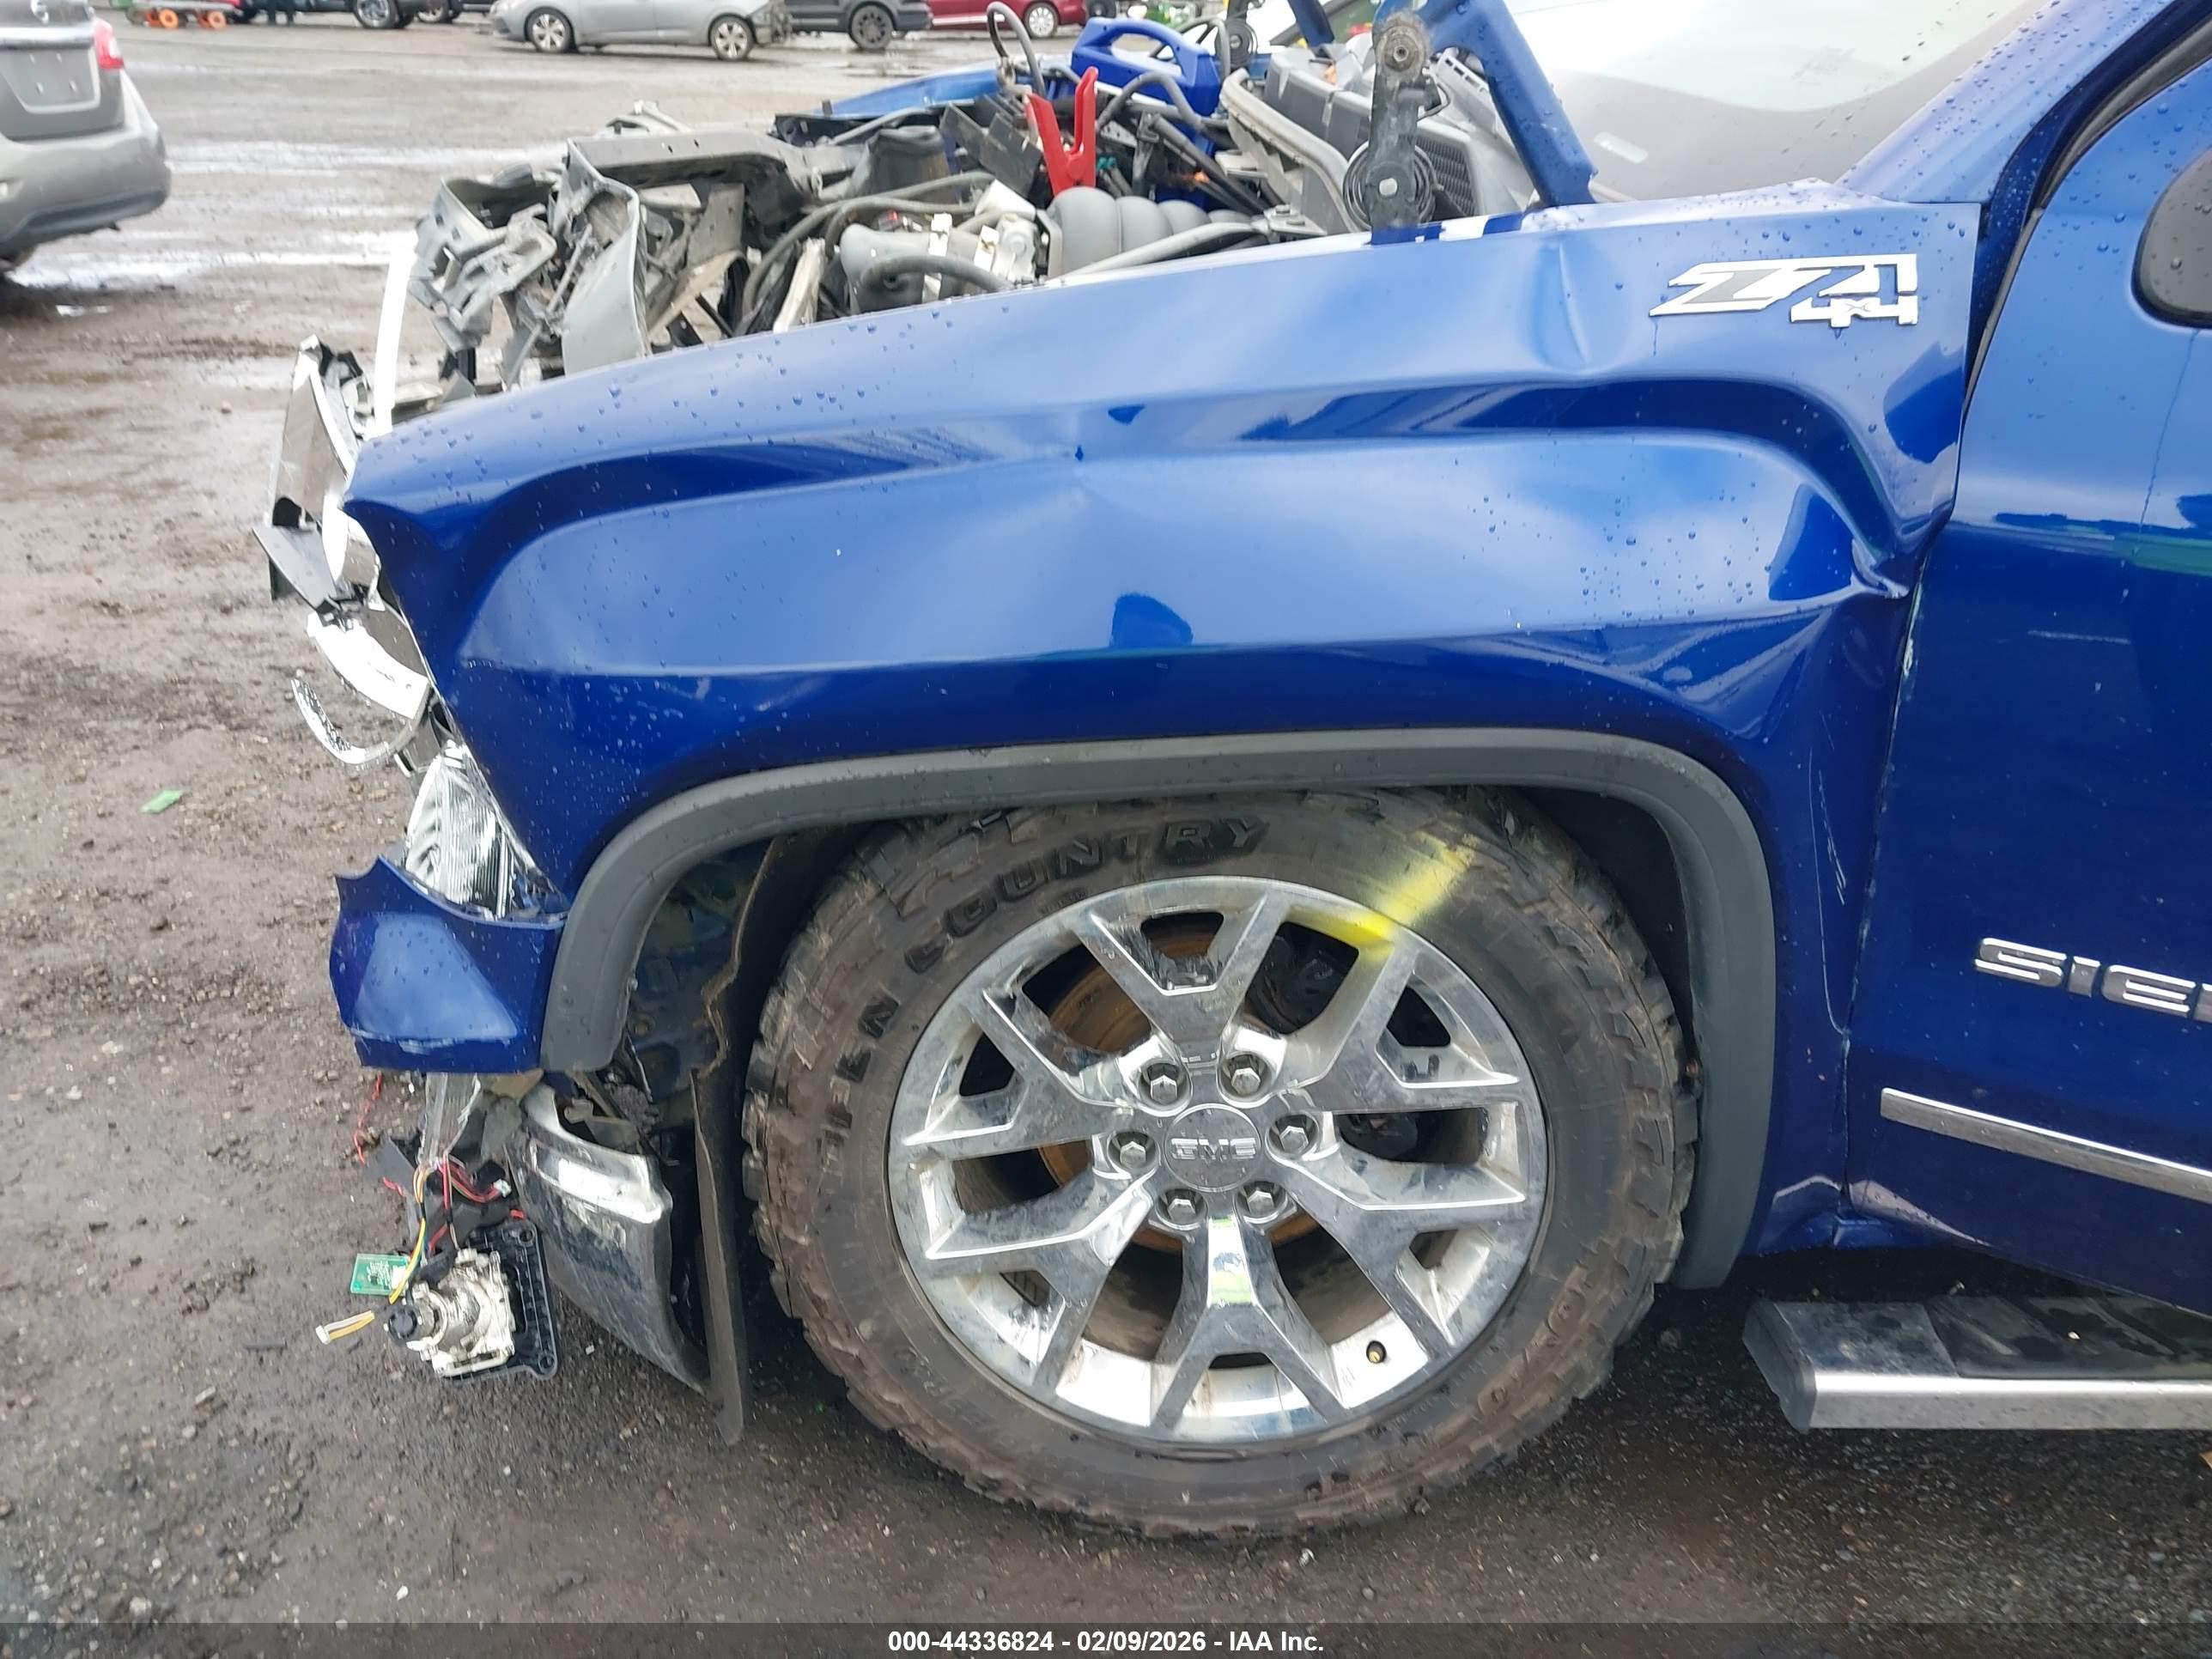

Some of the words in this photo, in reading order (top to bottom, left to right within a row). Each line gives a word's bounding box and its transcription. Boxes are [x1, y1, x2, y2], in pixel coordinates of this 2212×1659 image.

[1649, 253, 1917, 317] Z71
[904, 817, 1270, 975] COUNTRY
[1975, 937, 2212, 1024] SIE
[1170, 1138, 1256, 1159] GMC
